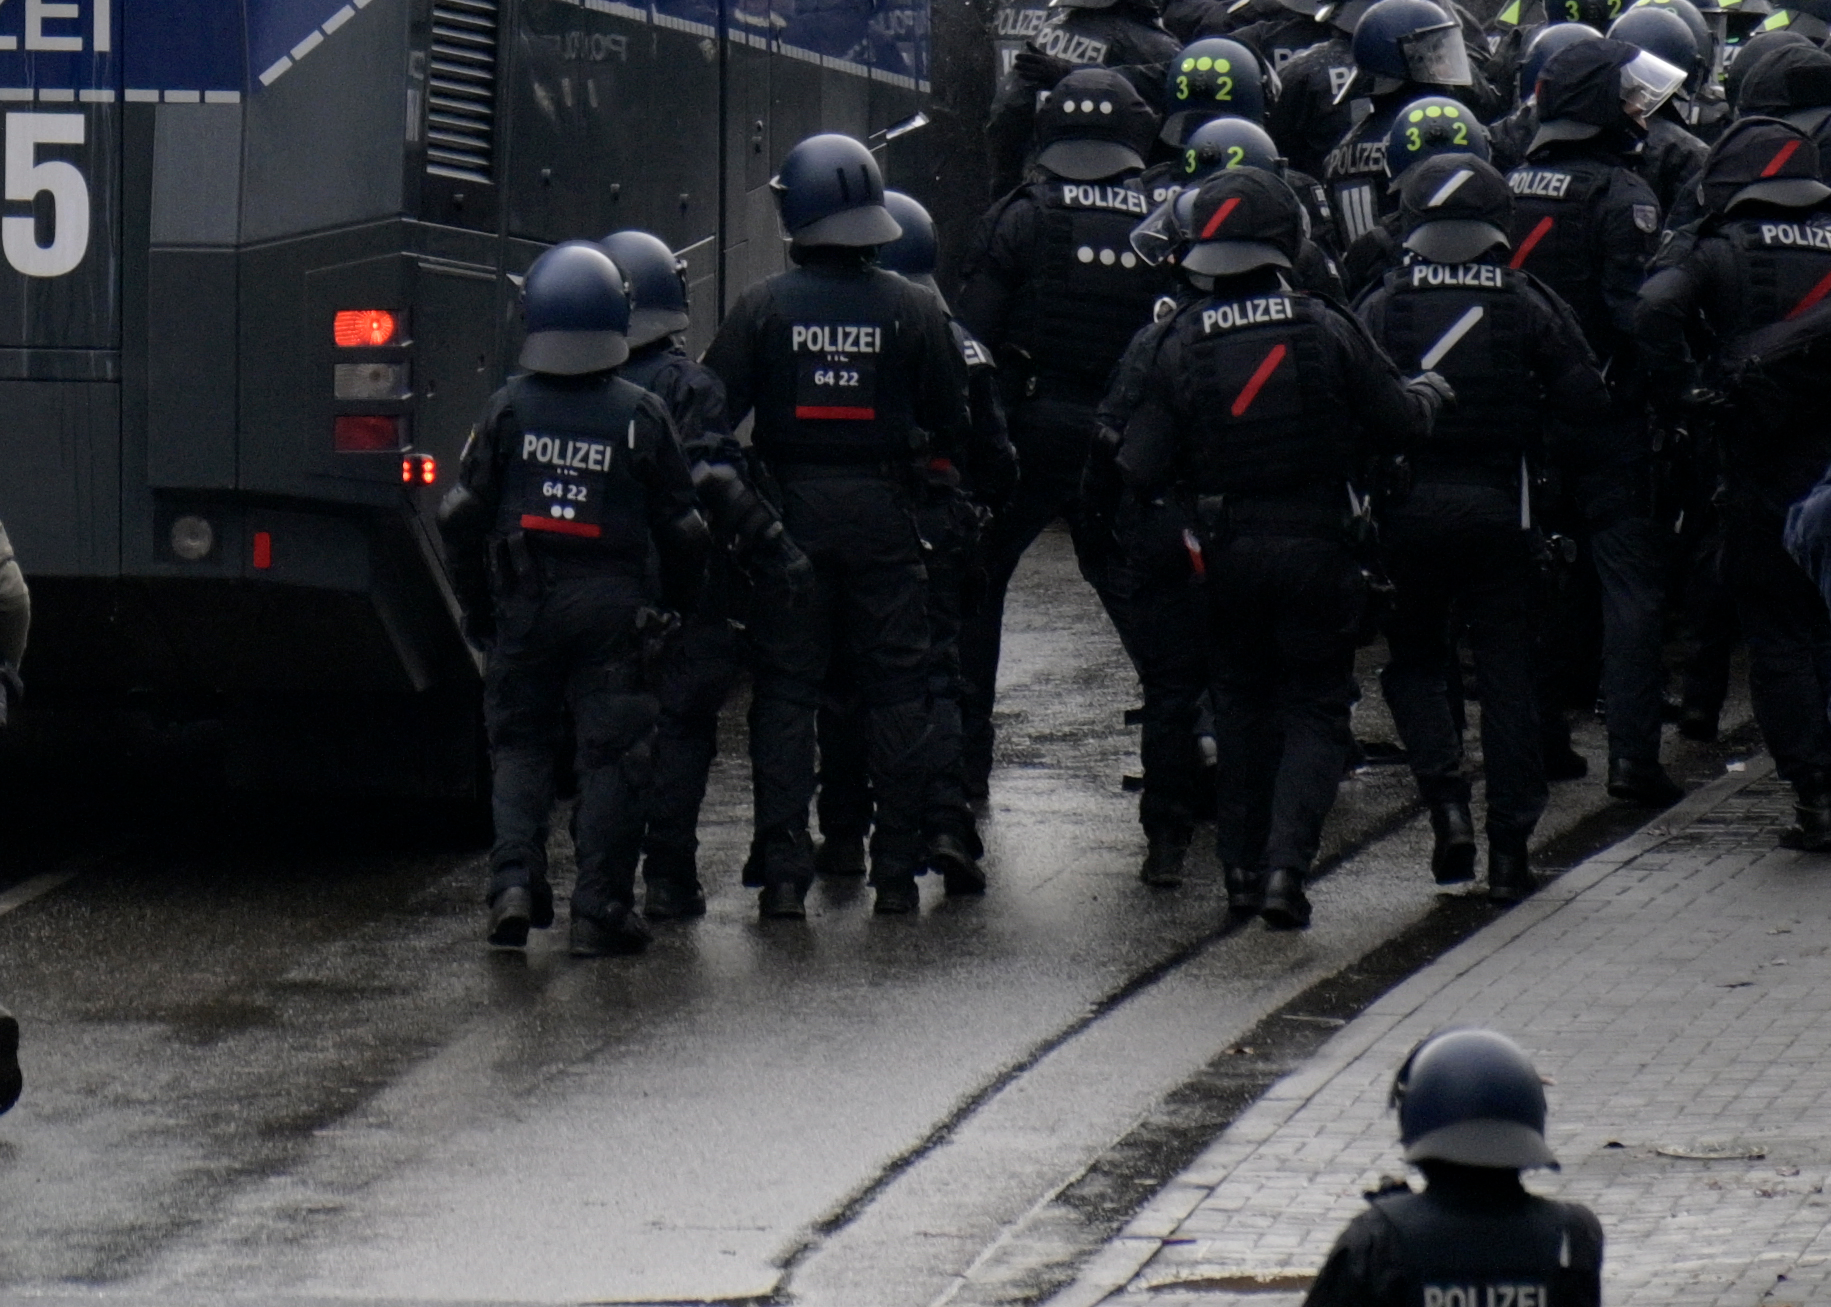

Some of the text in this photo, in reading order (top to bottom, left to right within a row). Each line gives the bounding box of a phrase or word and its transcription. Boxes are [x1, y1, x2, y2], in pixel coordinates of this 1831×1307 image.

[1565, 0, 1579, 21] 3
[1036, 27, 1107, 64] POLIZEI
[1176, 76, 1233, 100] 3 2
[1405, 122, 1468, 151] 3 2
[1185, 146, 1244, 173] 3 2
[2, 112, 90, 277] 5
[1063, 186, 1147, 214] POLIZEI
[1761, 224, 1831, 249] POLIZ
[1413, 265, 1502, 287] POLIZEI
[1203, 298, 1293, 333] POLIZEI
[791, 324, 881, 354] POLIZEI
[814, 370, 859, 387] 64 22
[522, 434, 612, 473] POLIZEI
[543, 481, 587, 501] 64 22
